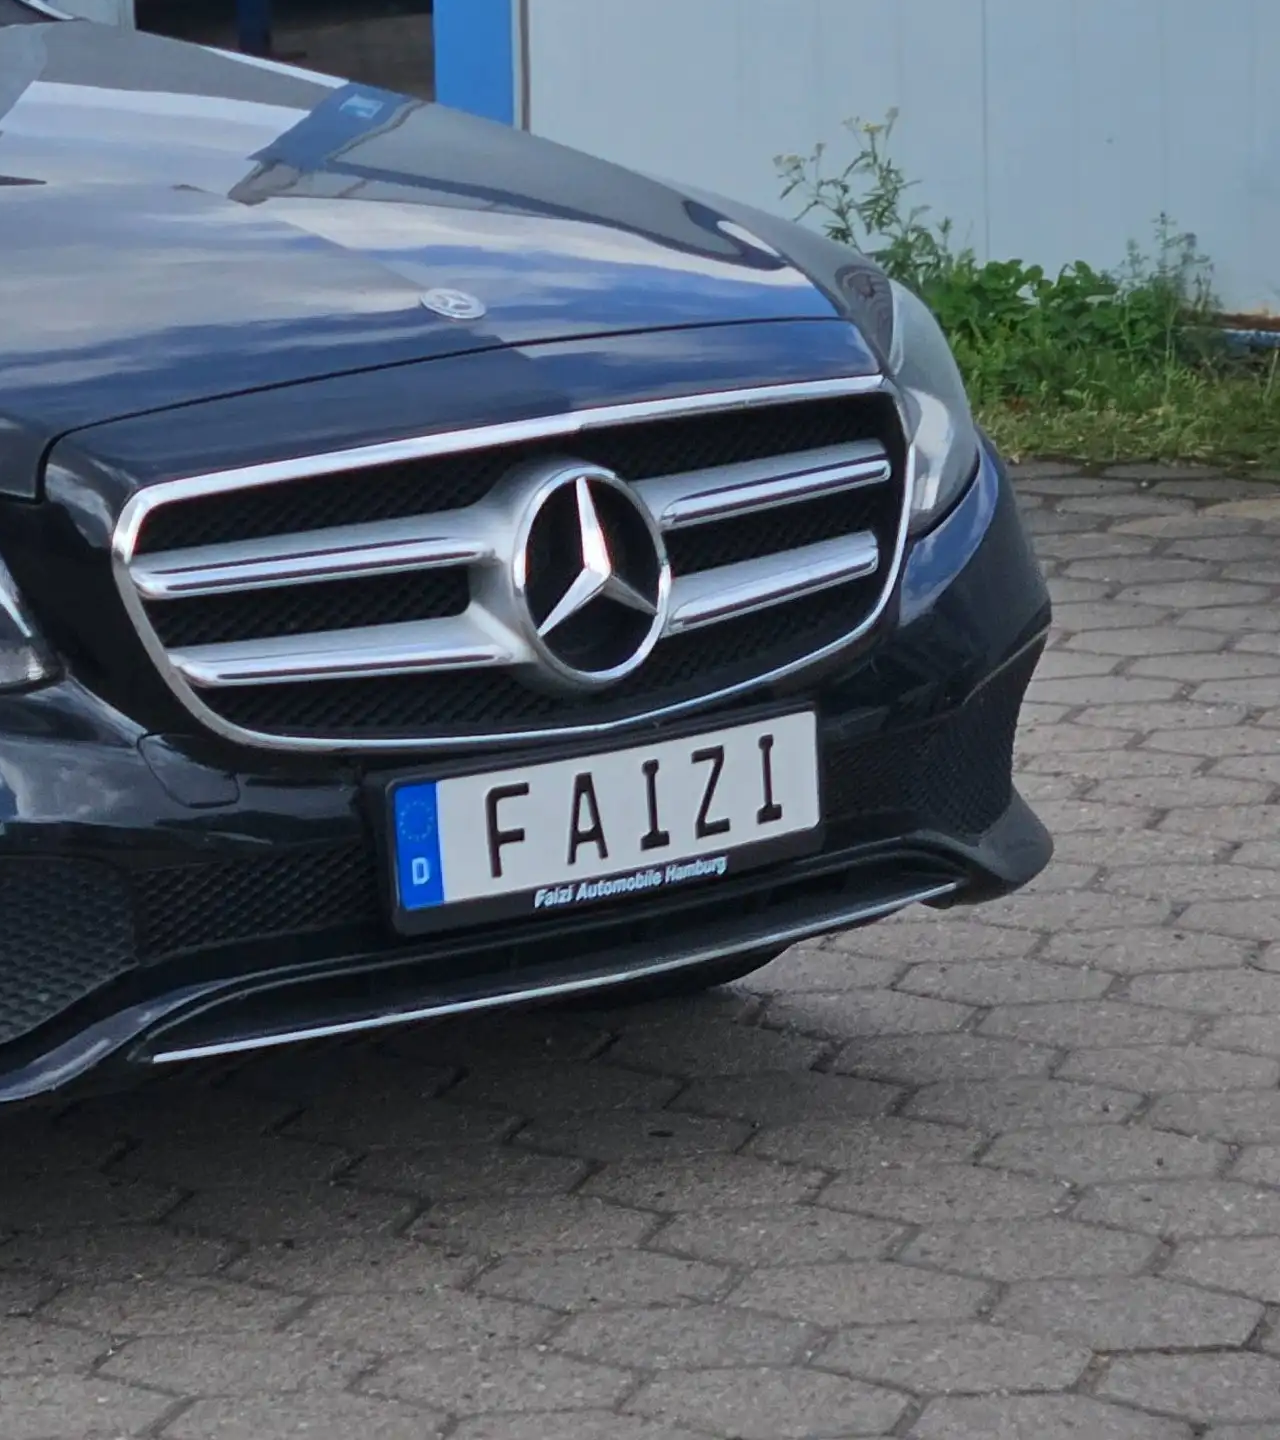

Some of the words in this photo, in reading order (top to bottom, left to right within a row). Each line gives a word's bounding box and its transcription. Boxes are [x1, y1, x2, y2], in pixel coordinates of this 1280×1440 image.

[411, 857, 430, 886] D
[485, 734, 782, 878] FAIZI
[534, 887, 573, 909] Faizi
[576, 871, 663, 902] Automobile
[665, 856, 728, 884] Hamburg
